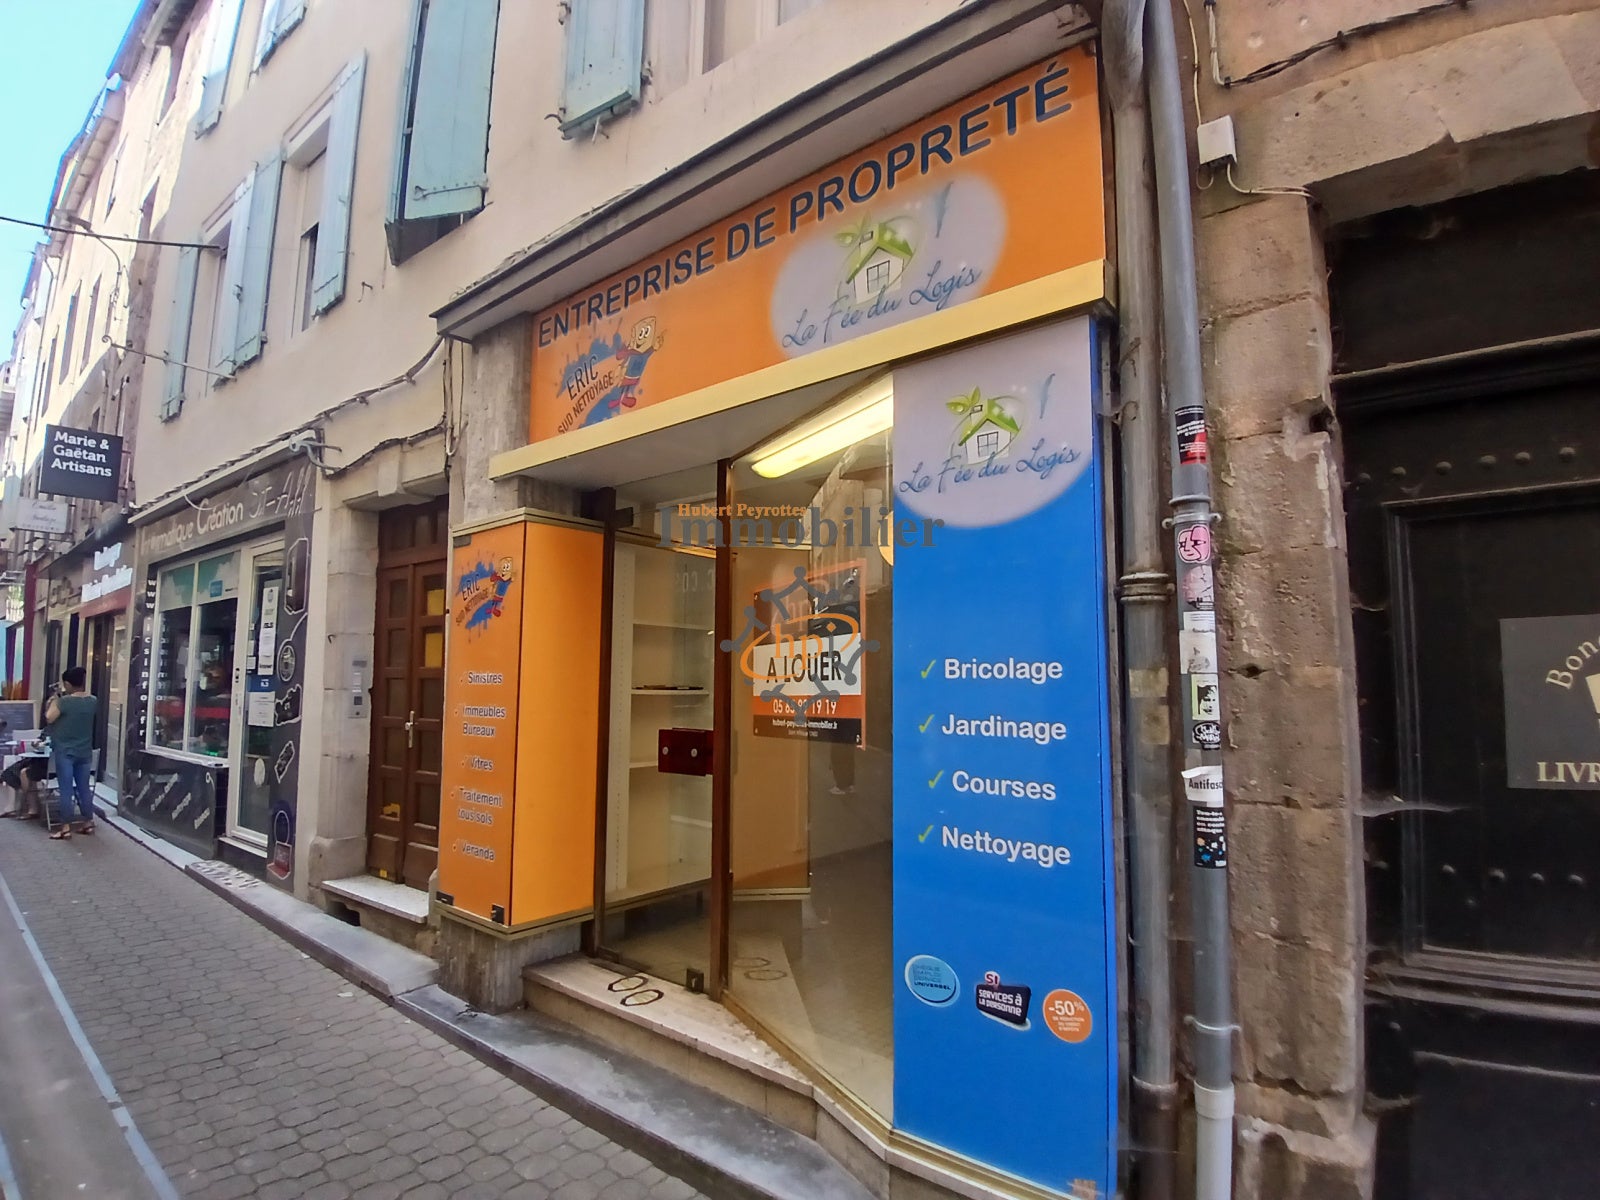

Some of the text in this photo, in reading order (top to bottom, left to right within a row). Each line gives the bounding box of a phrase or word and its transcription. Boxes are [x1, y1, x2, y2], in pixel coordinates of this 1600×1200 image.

[538, 62, 1072, 347] ENTREPRISE DE PROPRETÉ
[782, 308, 818, 348] La
[867, 285, 902, 319] du
[909, 260, 983, 311] Logis
[566, 355, 599, 401] ERIC
[557, 370, 614, 434] SUD NETTOYAGE
[53, 444, 107, 463] Gaëtan
[54, 431, 110, 450] Marie &
[51, 458, 112, 477] Artisans
[899, 461, 933, 493] La
[978, 451, 1010, 479] du
[1016, 438, 1082, 480] Logis
[197, 498, 243, 535] Création
[467, 671, 503, 686] Sinistres
[766, 650, 842, 684] A LOUER
[944, 657, 1063, 685] Bricolage
[463, 705, 506, 719] Immeubles
[773, 699, 783, 713] 05
[812, 699, 822, 714] 19
[462, 722, 496, 737] Bureaux
[941, 714, 1067, 745] Jardinage
[952, 769, 1057, 801] Courses
[941, 825, 1071, 868] Nettoyage
